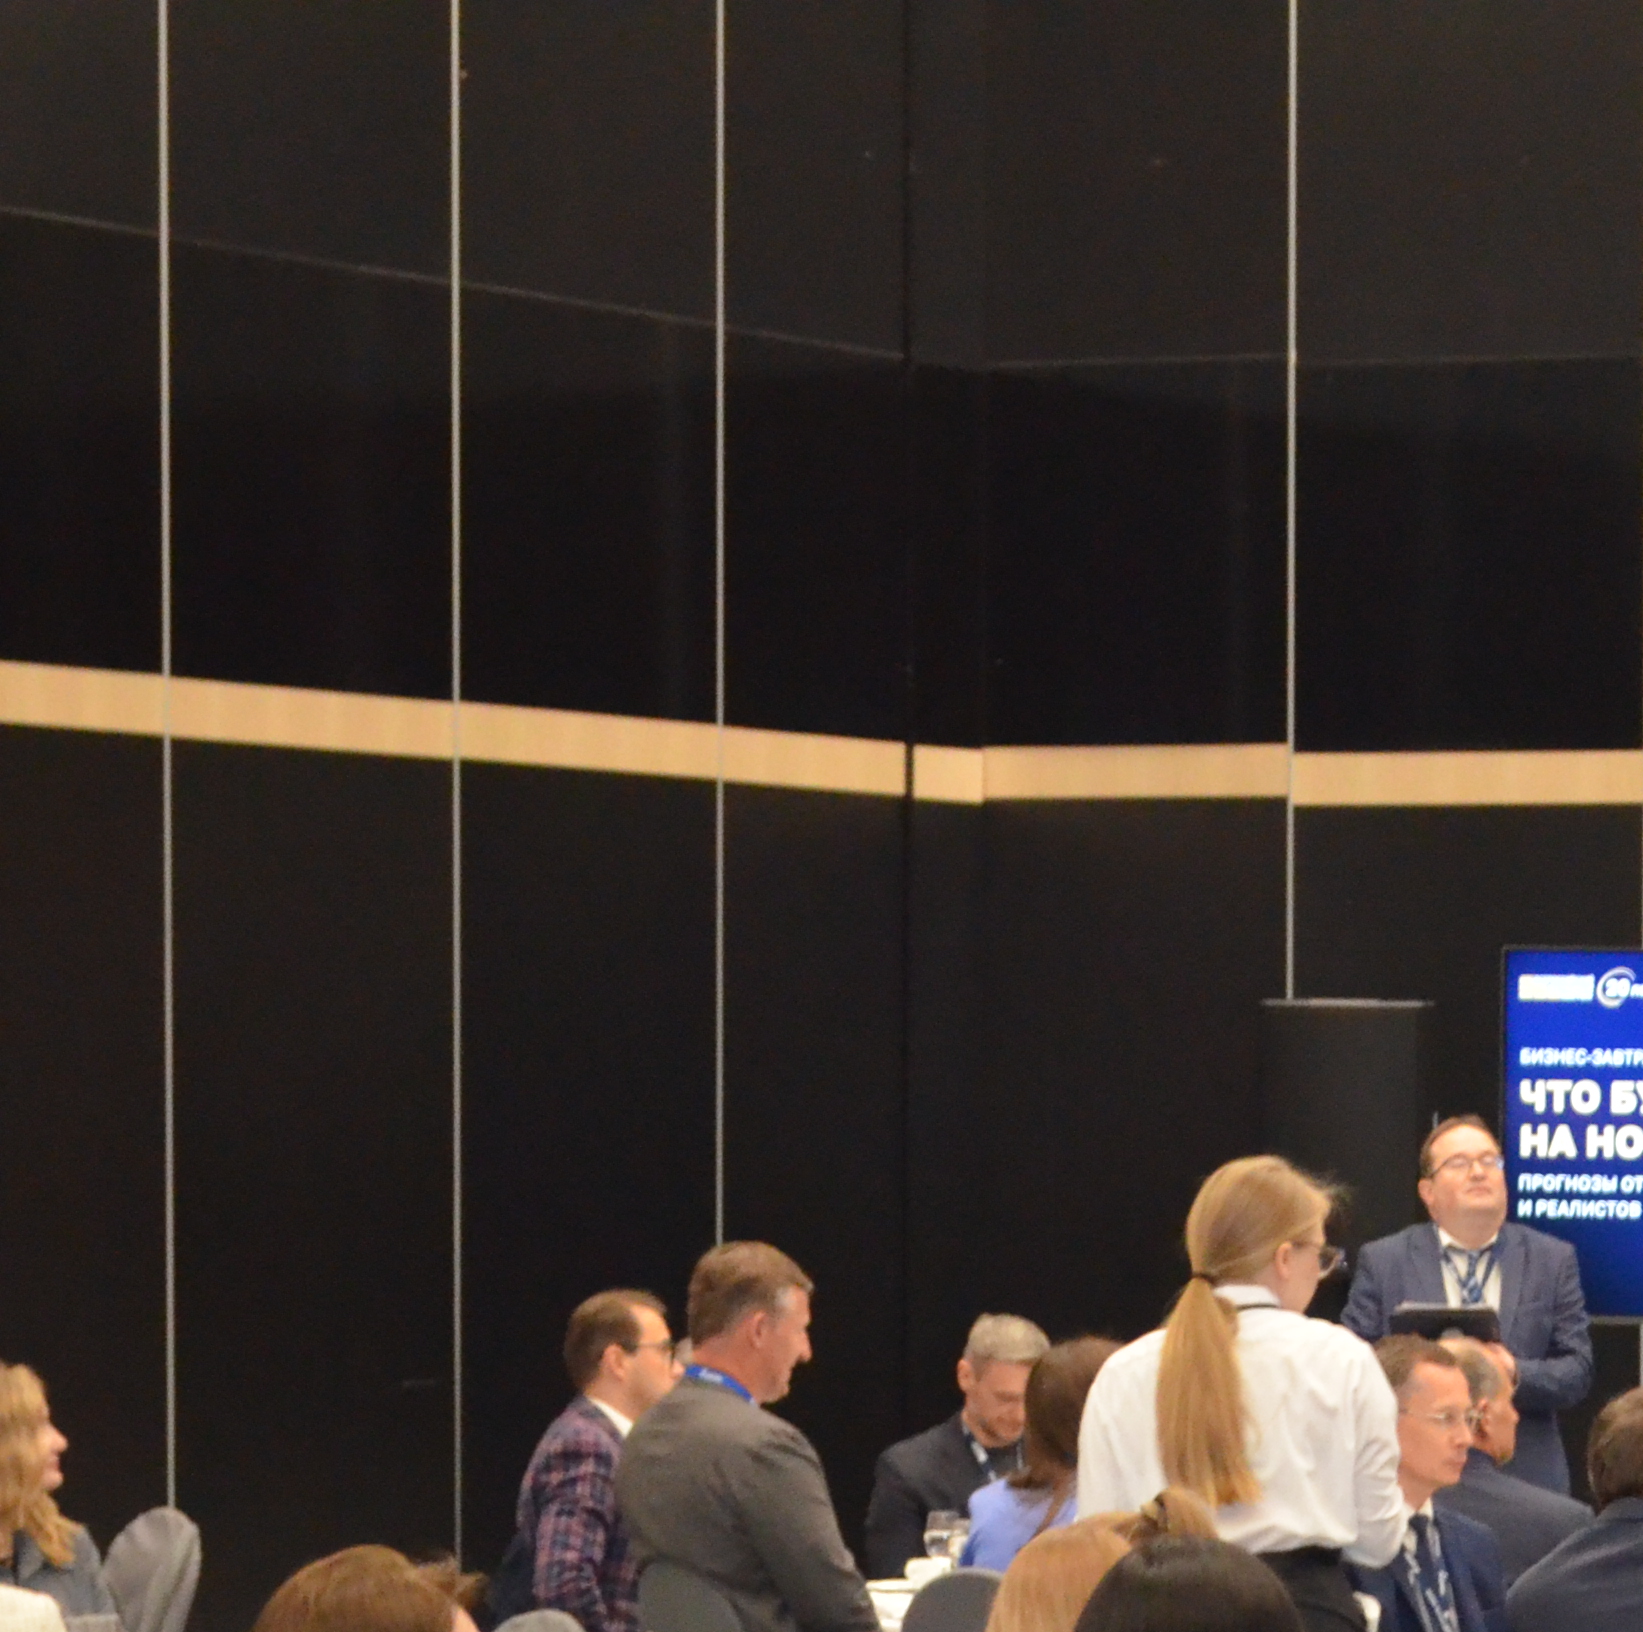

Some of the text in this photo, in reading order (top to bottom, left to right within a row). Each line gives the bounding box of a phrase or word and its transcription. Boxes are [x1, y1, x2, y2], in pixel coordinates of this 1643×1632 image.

[1519, 1079, 1600, 1115] ЧТО
[1519, 1124, 1576, 1160] НА
[1518, 1174, 1617, 1194] ПРОГНОЗЫ
[1518, 1201, 1642, 1219] И РЕАЛИСТОВ
